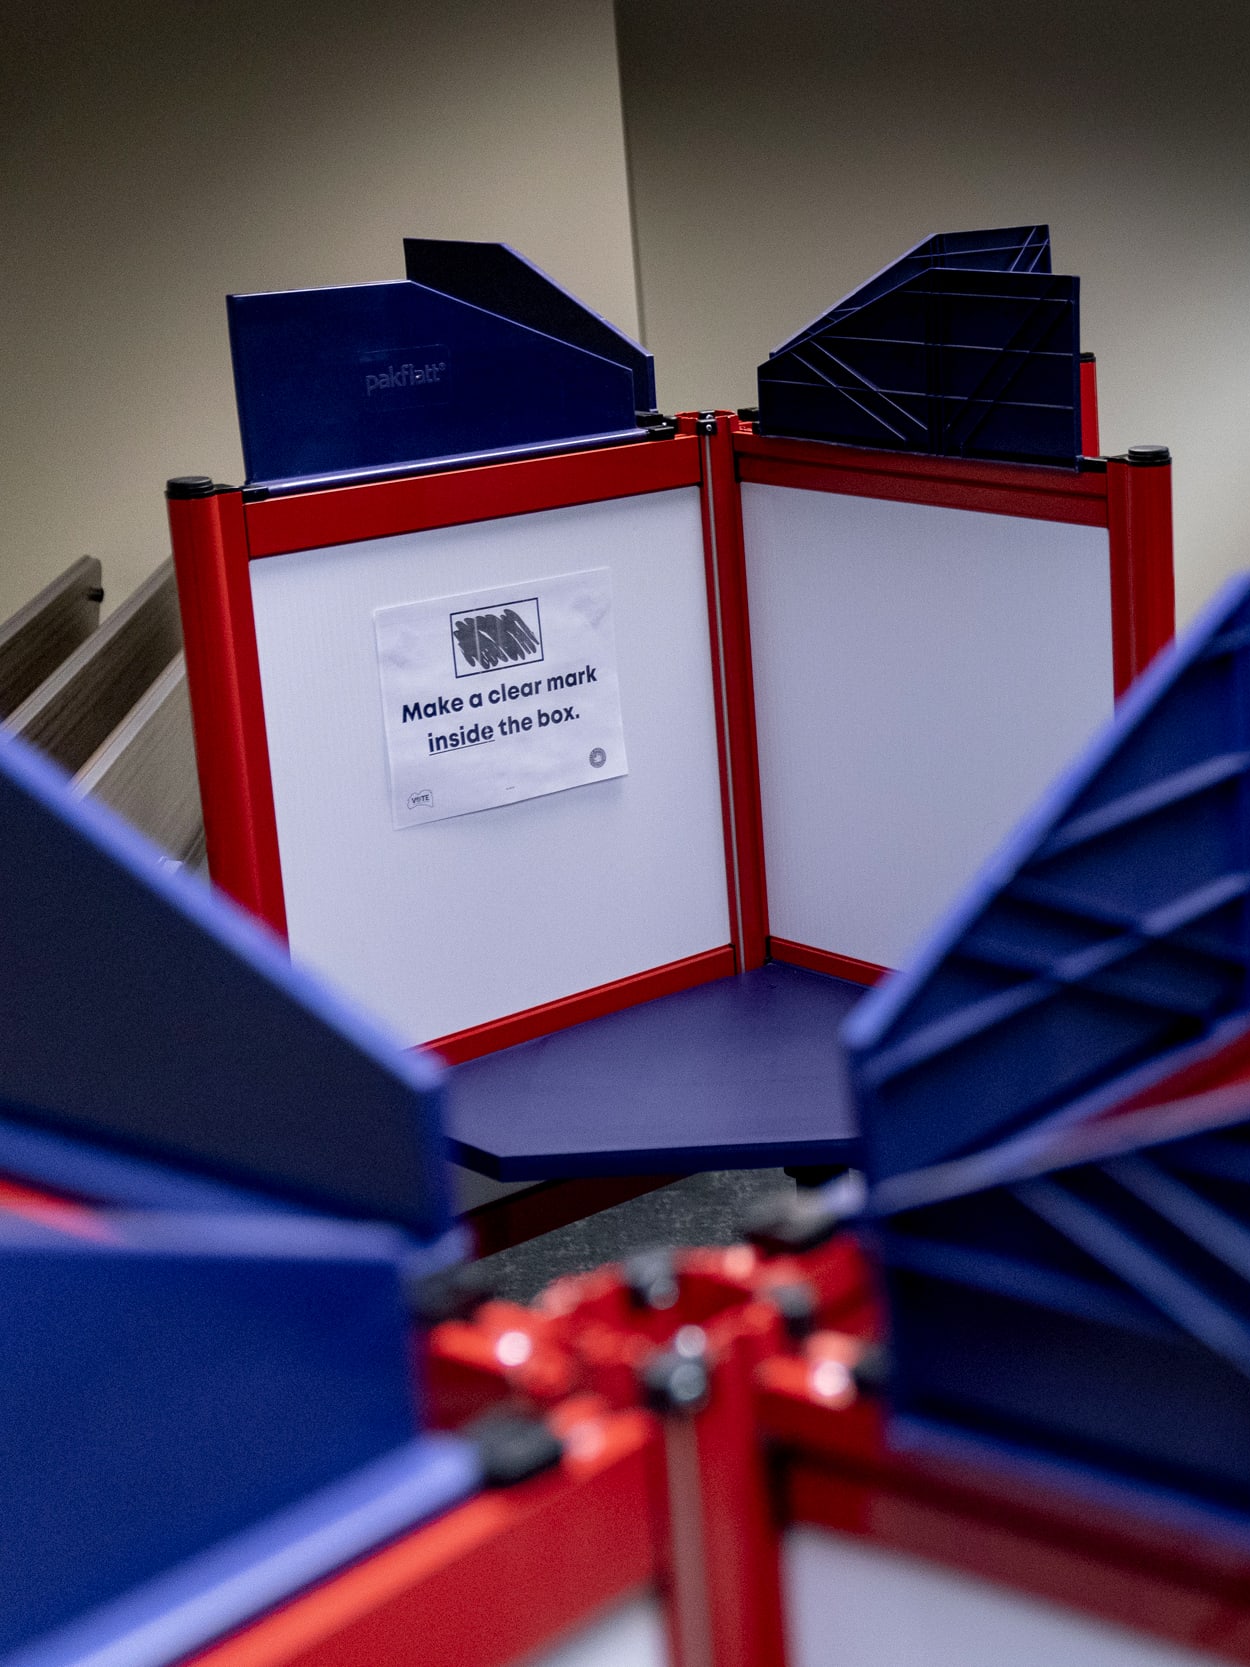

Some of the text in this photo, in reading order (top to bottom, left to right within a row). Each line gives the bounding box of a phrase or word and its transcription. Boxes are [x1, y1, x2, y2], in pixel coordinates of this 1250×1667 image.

[401, 665, 598, 723] Make a clear mark
[427, 705, 580, 753] inside the box.
[411, 794, 430, 804] VOTE
